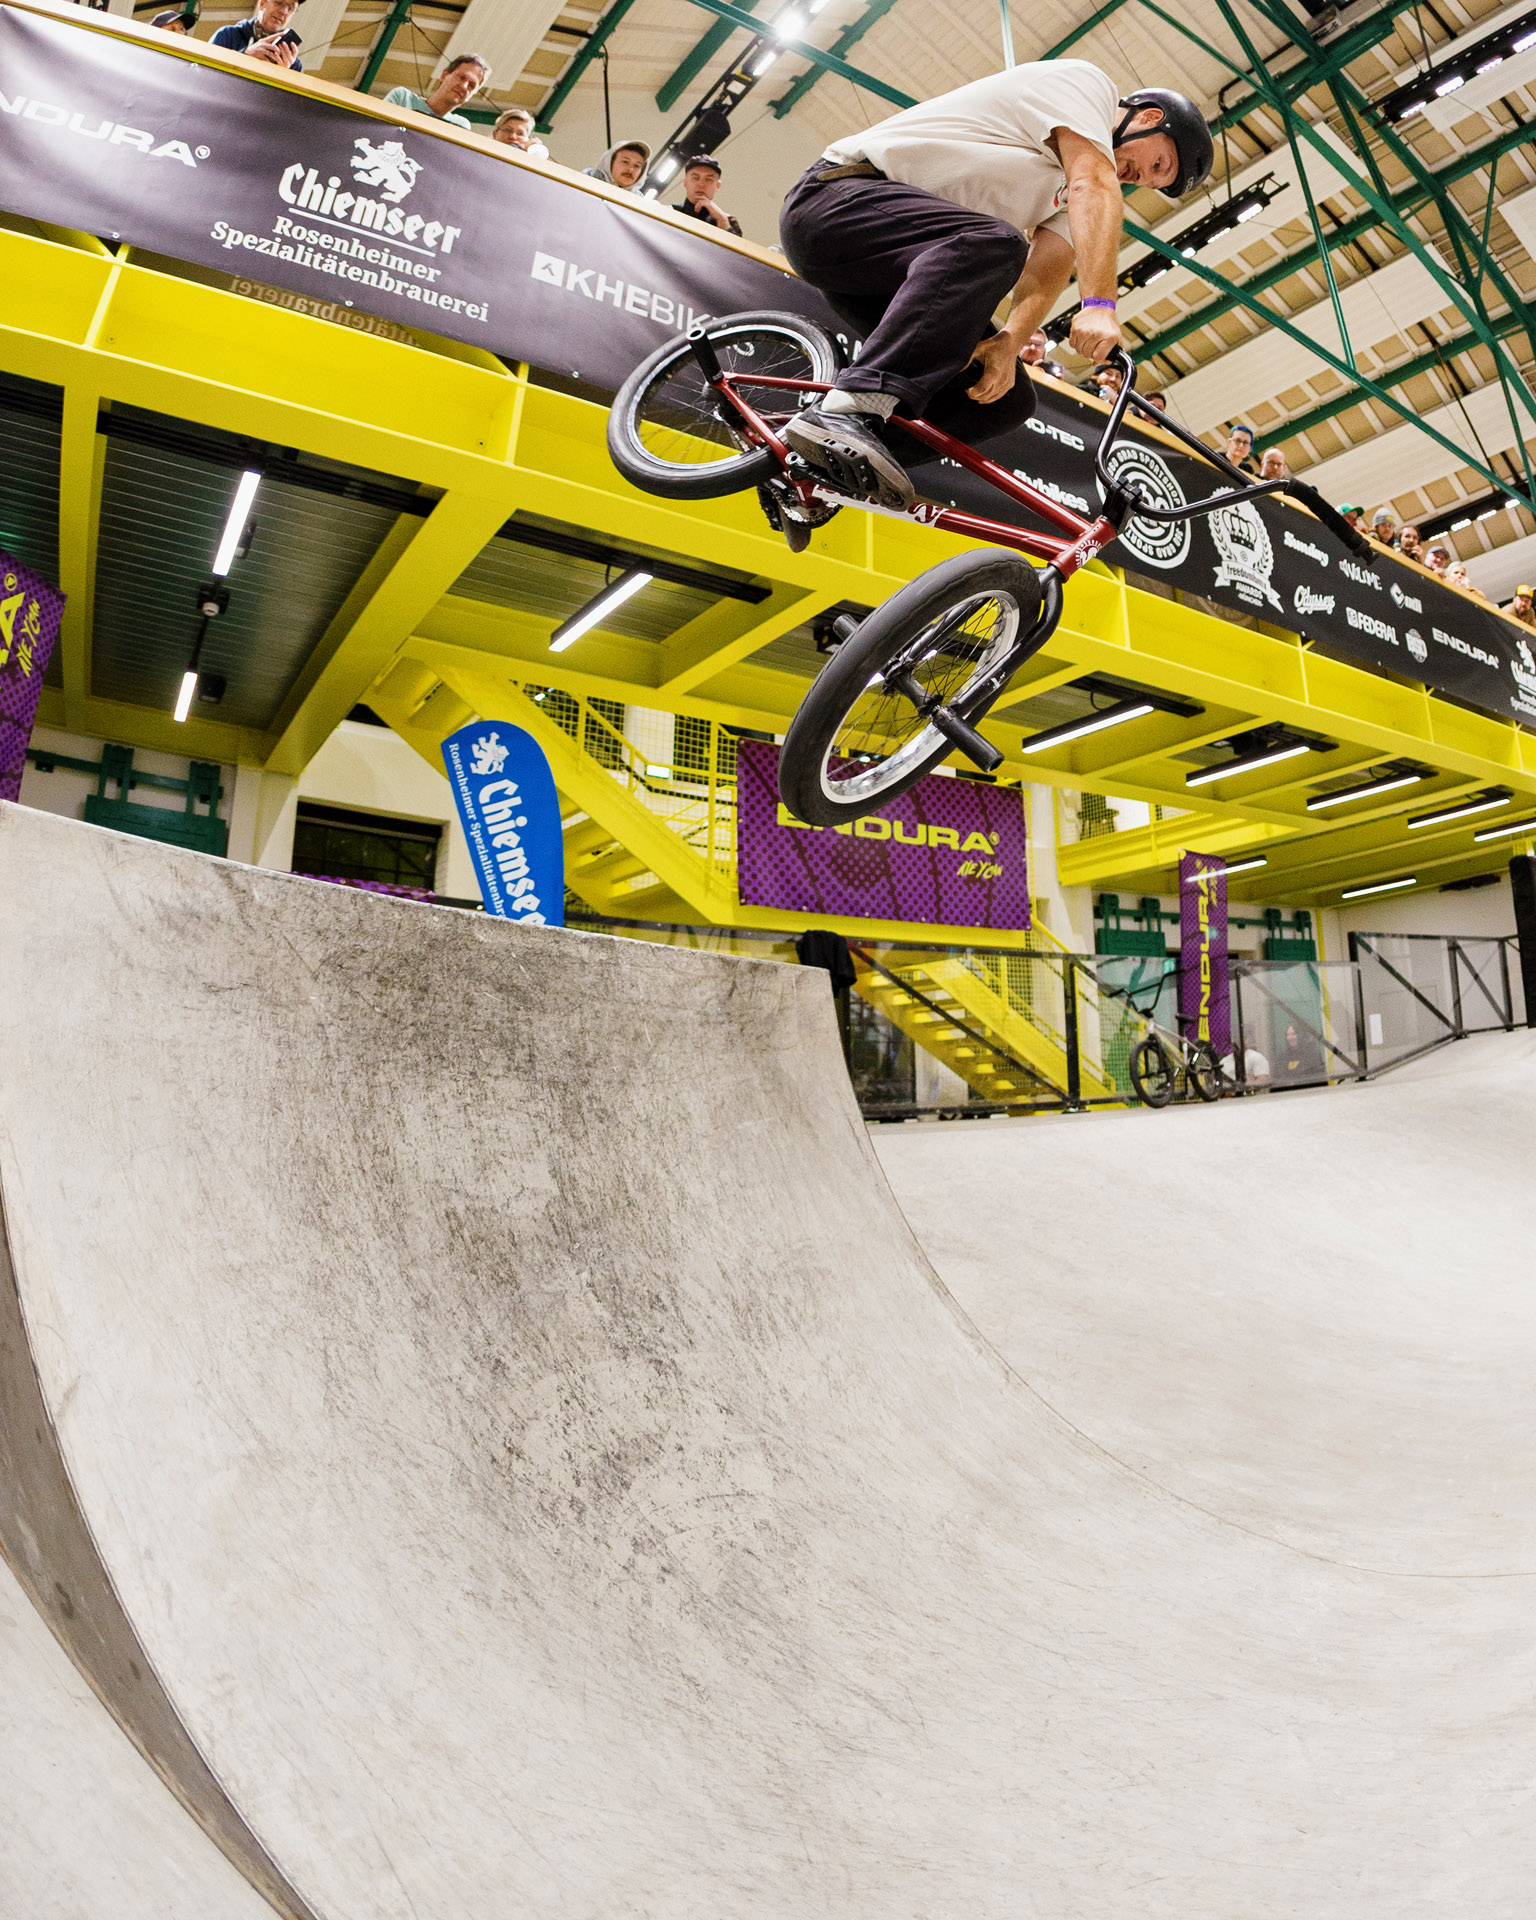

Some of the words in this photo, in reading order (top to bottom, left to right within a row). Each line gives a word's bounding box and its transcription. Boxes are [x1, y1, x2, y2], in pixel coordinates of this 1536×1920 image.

[0, 90, 197, 168] NDURA
[278, 163, 461, 254] Chiemseer
[210, 220, 489, 322] Spezialitätenbrauerei
[271, 215, 442, 283] Rosenheimer
[1024, 417, 1085, 451] O-TEC
[1116, 449, 1139, 461] GRAD
[1283, 531, 1329, 567] Sunday
[1294, 585, 1336, 615] Odyssey
[1358, 612, 1400, 646] FEDERAL
[1432, 627, 1499, 669] ENDURA
[449, 742, 478, 821] Rosenheimer
[478, 778, 547, 924] Chiemsee
